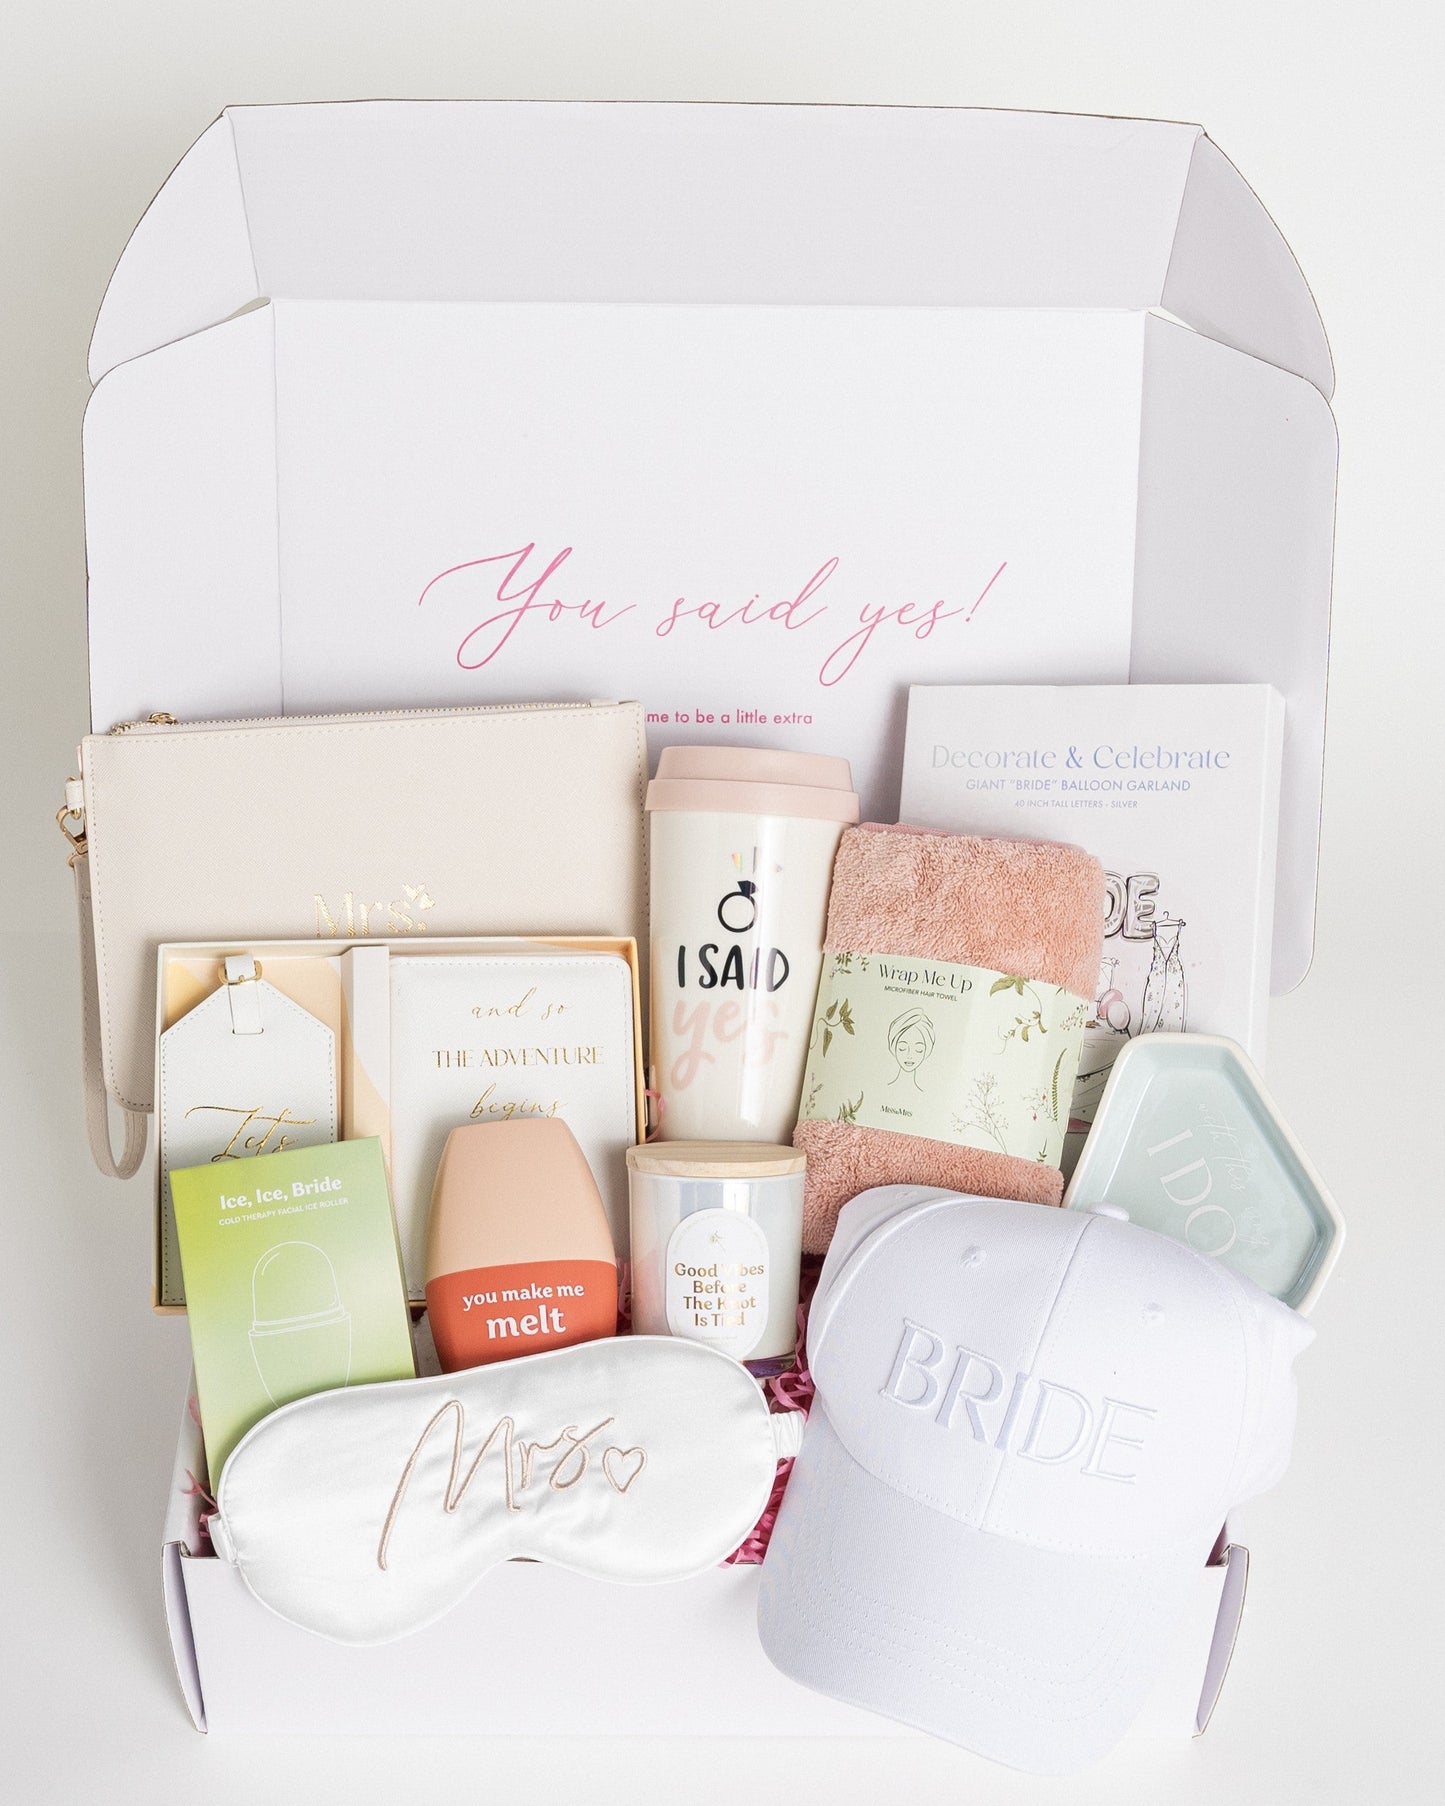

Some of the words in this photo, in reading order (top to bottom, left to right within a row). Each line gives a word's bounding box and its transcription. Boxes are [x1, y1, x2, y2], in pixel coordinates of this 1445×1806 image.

[419, 543, 637, 669] You
[656, 557, 839, 637] said
[819, 562, 1007, 686] yes!
[675, 711, 690, 724] to
[696, 709, 714, 724] be
[721, 713, 730, 724] a
[736, 709, 767, 724] little
[773, 711, 813, 724] extra
[931, 745, 1057, 769] Decorate
[1065, 745, 1083, 769] &
[1093, 745, 1230, 769] Celebrate
[966, 779, 1007, 791] GIANT
[1061, 779, 1122, 791] BALLOON
[1127, 780, 1191, 791] GARLAND
[1015, 800, 1025, 808] 40
[1027, 800, 1049, 808] INCH
[1051, 800, 1068, 808] TALL
[1071, 800, 1103, 809] LETTERS
[1111, 800, 1138, 809] SILVER
[678, 945, 686, 989] I
[699, 943, 790, 992] SAID
[879, 963, 919, 985] Wrap
[922, 969, 946, 987] Me
[950, 973, 973, 994] Up
[472, 987, 537, 1019] and
[541, 1003, 572, 1021] so
[884, 985, 919, 995] MICROFIBER
[920, 989, 935, 998] HAIR
[937, 992, 958, 1001] TOWEL
[432, 1049, 475, 1068] THE
[480, 1046, 605, 1067] ADVENTURE
[470, 1083, 568, 1120] begins
[1147, 1128, 1193, 1156] I
[220, 1195, 253, 1210] Ice,
[256, 1189, 288, 1203] Ice,
[292, 1176, 342, 1197] Bride
[1160, 1157, 1236, 1257] DO
[219, 1216, 241, 1226] COLD
[242, 1210, 276, 1221] THERAPY
[278, 1205, 304, 1216] FACIAL
[305, 1201, 318, 1211] ICE
[319, 1197, 349, 1208] ROLLER
[674, 1262, 718, 1277] Good
[462, 1291, 497, 1312] you
[502, 1283, 553, 1302] make
[557, 1284, 585, 1297] me
[683, 1296, 713, 1310] The
[486, 1304, 566, 1339] melt
[695, 1313, 708, 1327] Is
[879, 1316, 1158, 1485] BRIDE
[377, 1400, 615, 1571] Mrs
